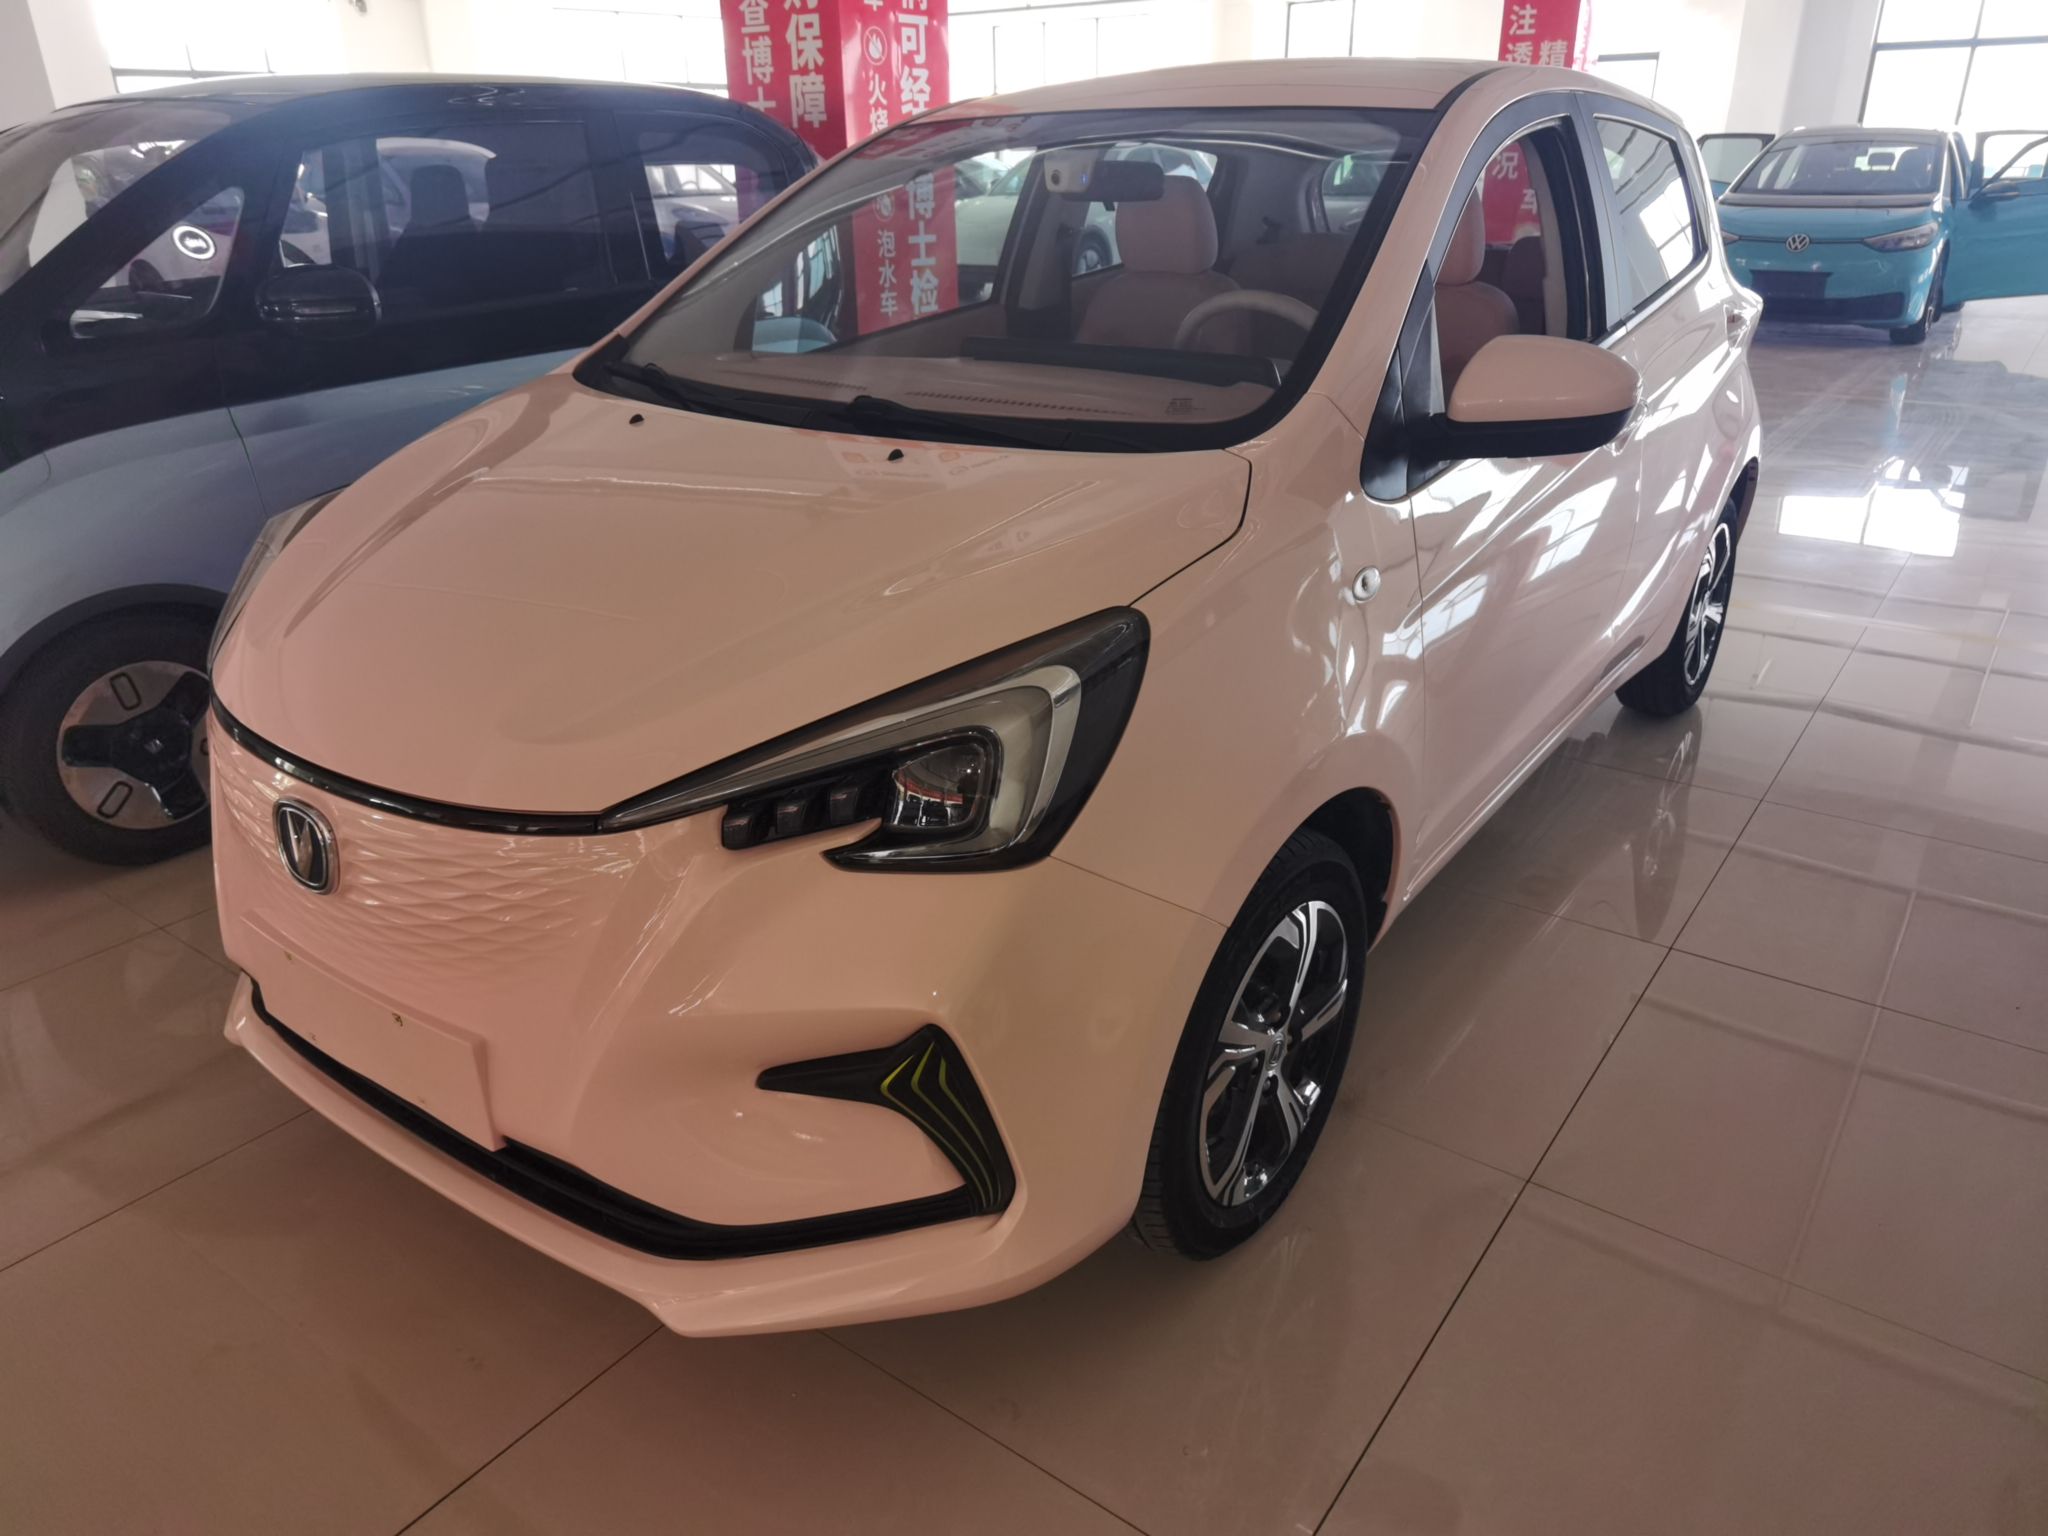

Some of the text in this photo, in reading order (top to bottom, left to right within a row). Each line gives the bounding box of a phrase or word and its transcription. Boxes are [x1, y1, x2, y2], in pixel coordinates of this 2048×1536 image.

[877, 229, 898, 318] 泡水车
[904, 172, 939, 318] 博士检
